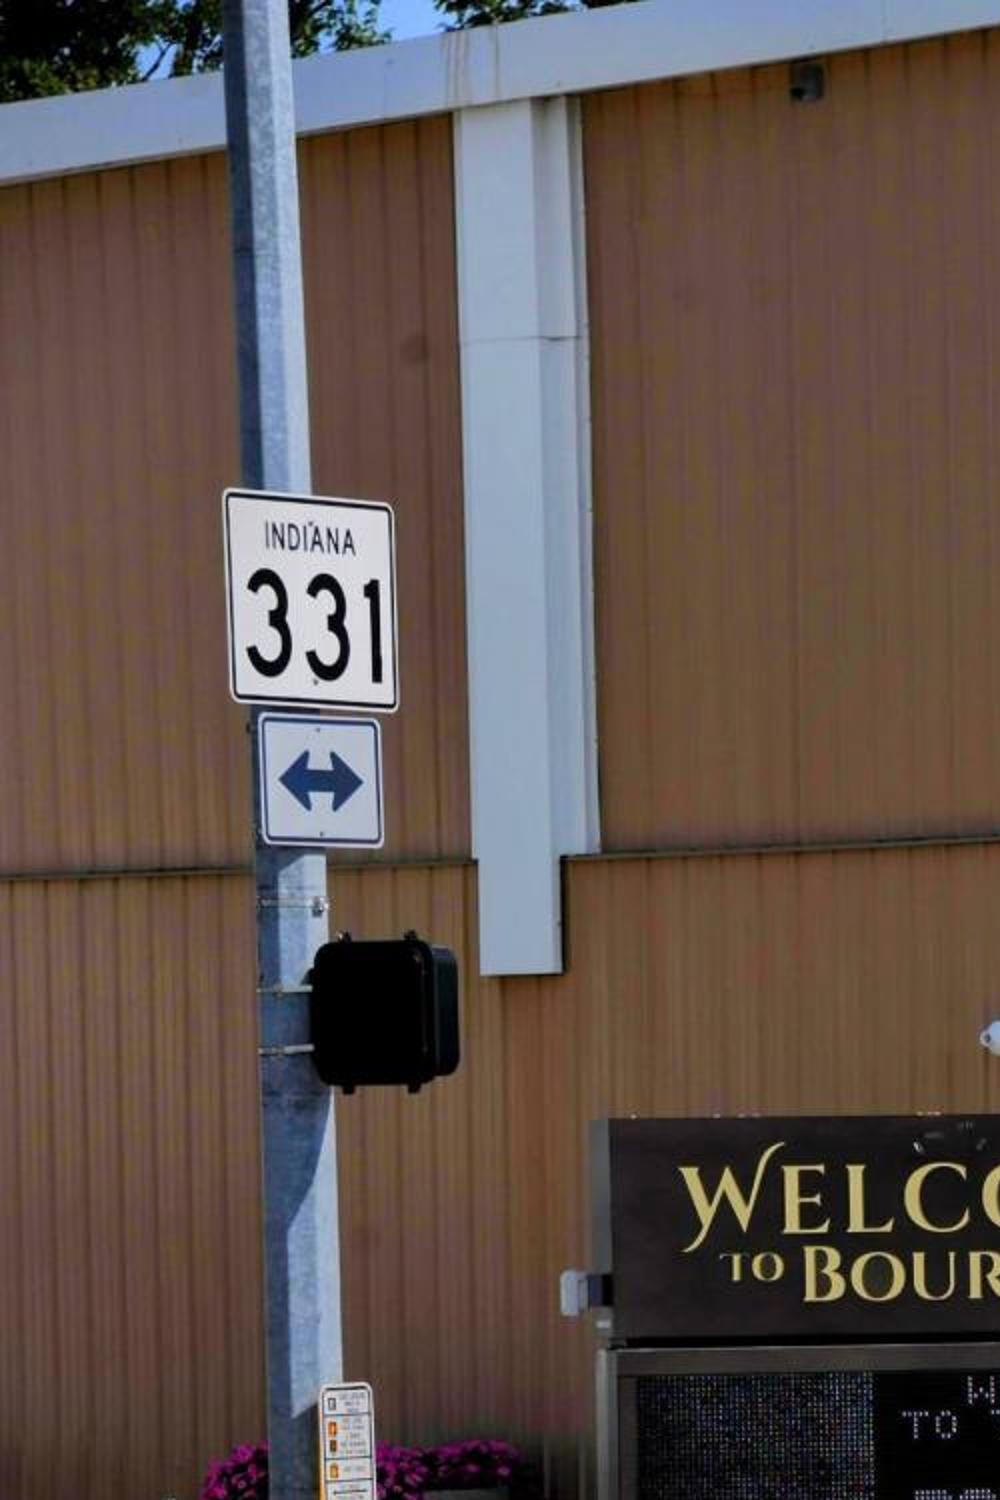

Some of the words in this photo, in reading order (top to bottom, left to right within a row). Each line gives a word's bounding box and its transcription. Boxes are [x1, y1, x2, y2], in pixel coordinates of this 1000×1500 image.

[264, 520, 356, 556] INDIANA
[246, 567, 383, 685] 331
[719, 1252, 785, 1282] TO
[901, 1409, 959, 1440] TO
